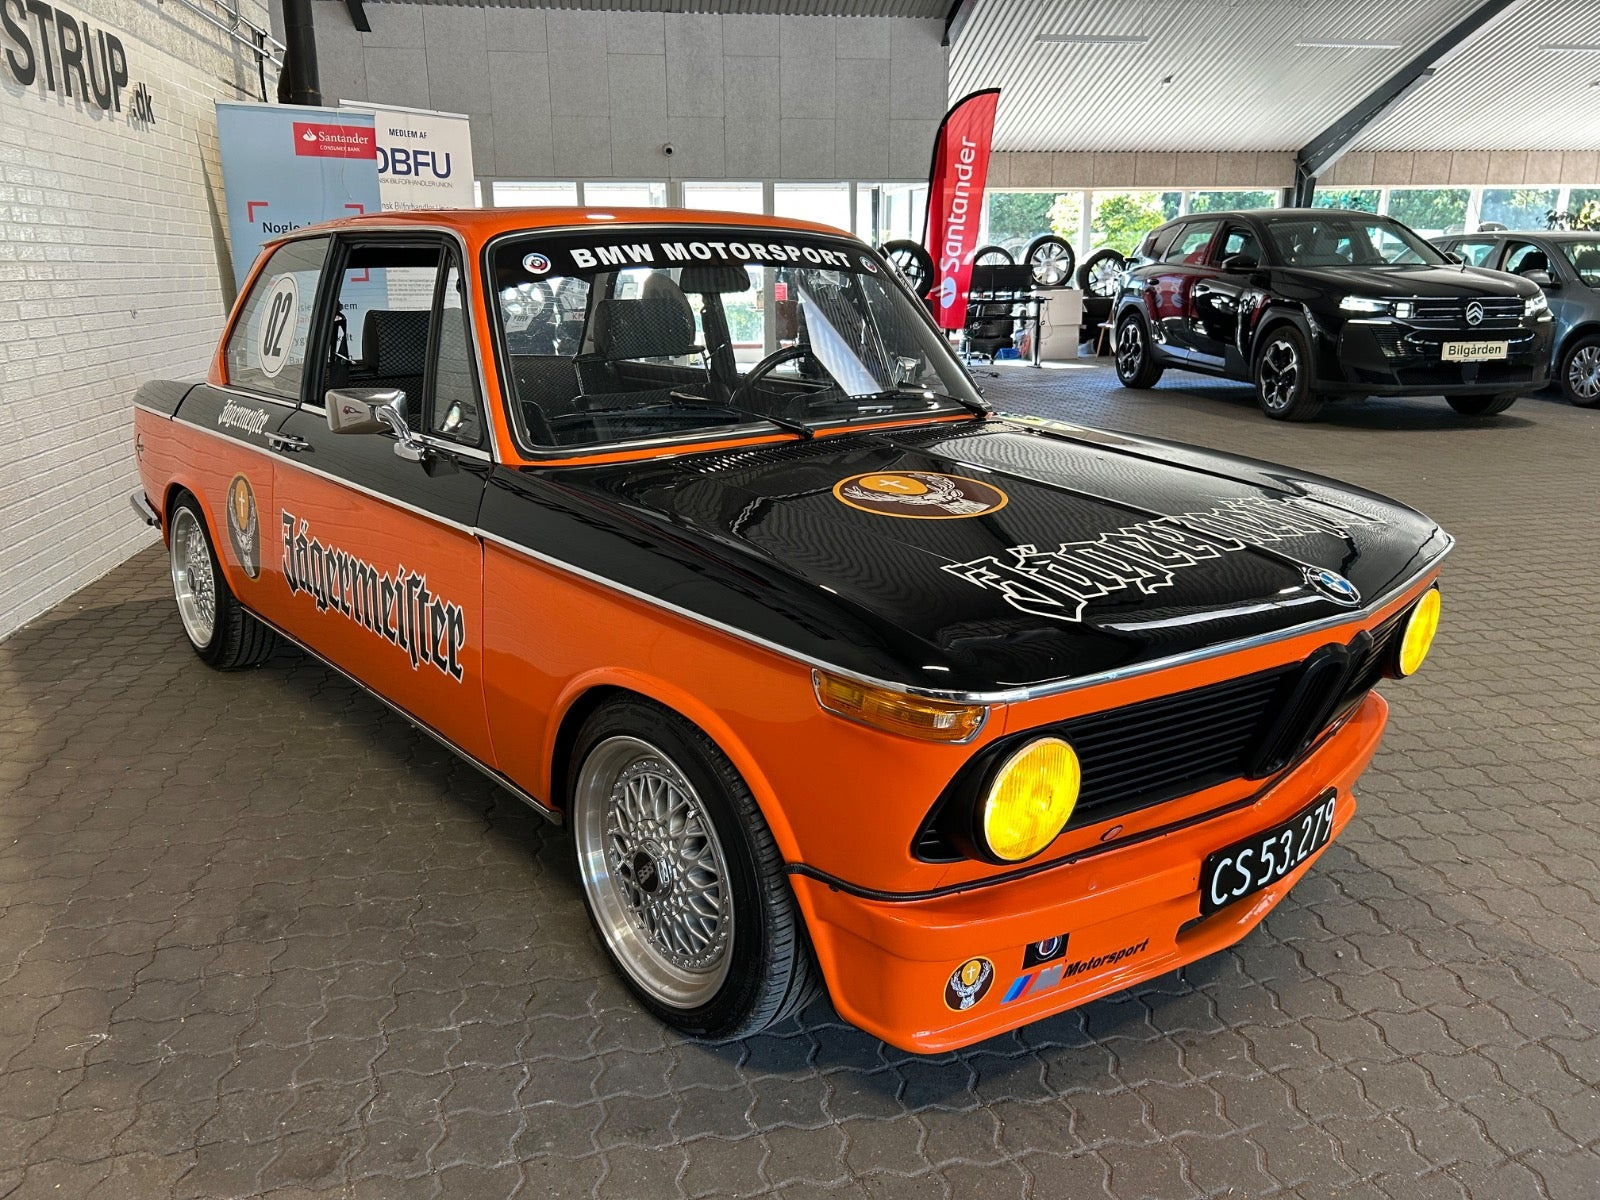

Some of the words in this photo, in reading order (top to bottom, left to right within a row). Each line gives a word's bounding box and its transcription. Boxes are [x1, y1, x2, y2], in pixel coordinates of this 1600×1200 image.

[318, 131, 368, 144] Santander
[389, 128, 417, 138] MEDLEM
[419, 131, 427, 139] AF
[390, 177, 435, 187] BILFORHANDLER
[939, 136, 976, 273] Santander
[570, 243, 655, 269] BMW
[660, 242, 851, 268] MOTORSPORT
[263, 291, 293, 357] 02
[1448, 344, 1502, 358] Bilgården
[218, 399, 270, 436] Jägermeister
[281, 508, 465, 684] Jägermeister
[1211, 848, 1254, 905] CS
[1257, 797, 1336, 886] 53.279
[1062, 938, 1149, 979] Motorsport
